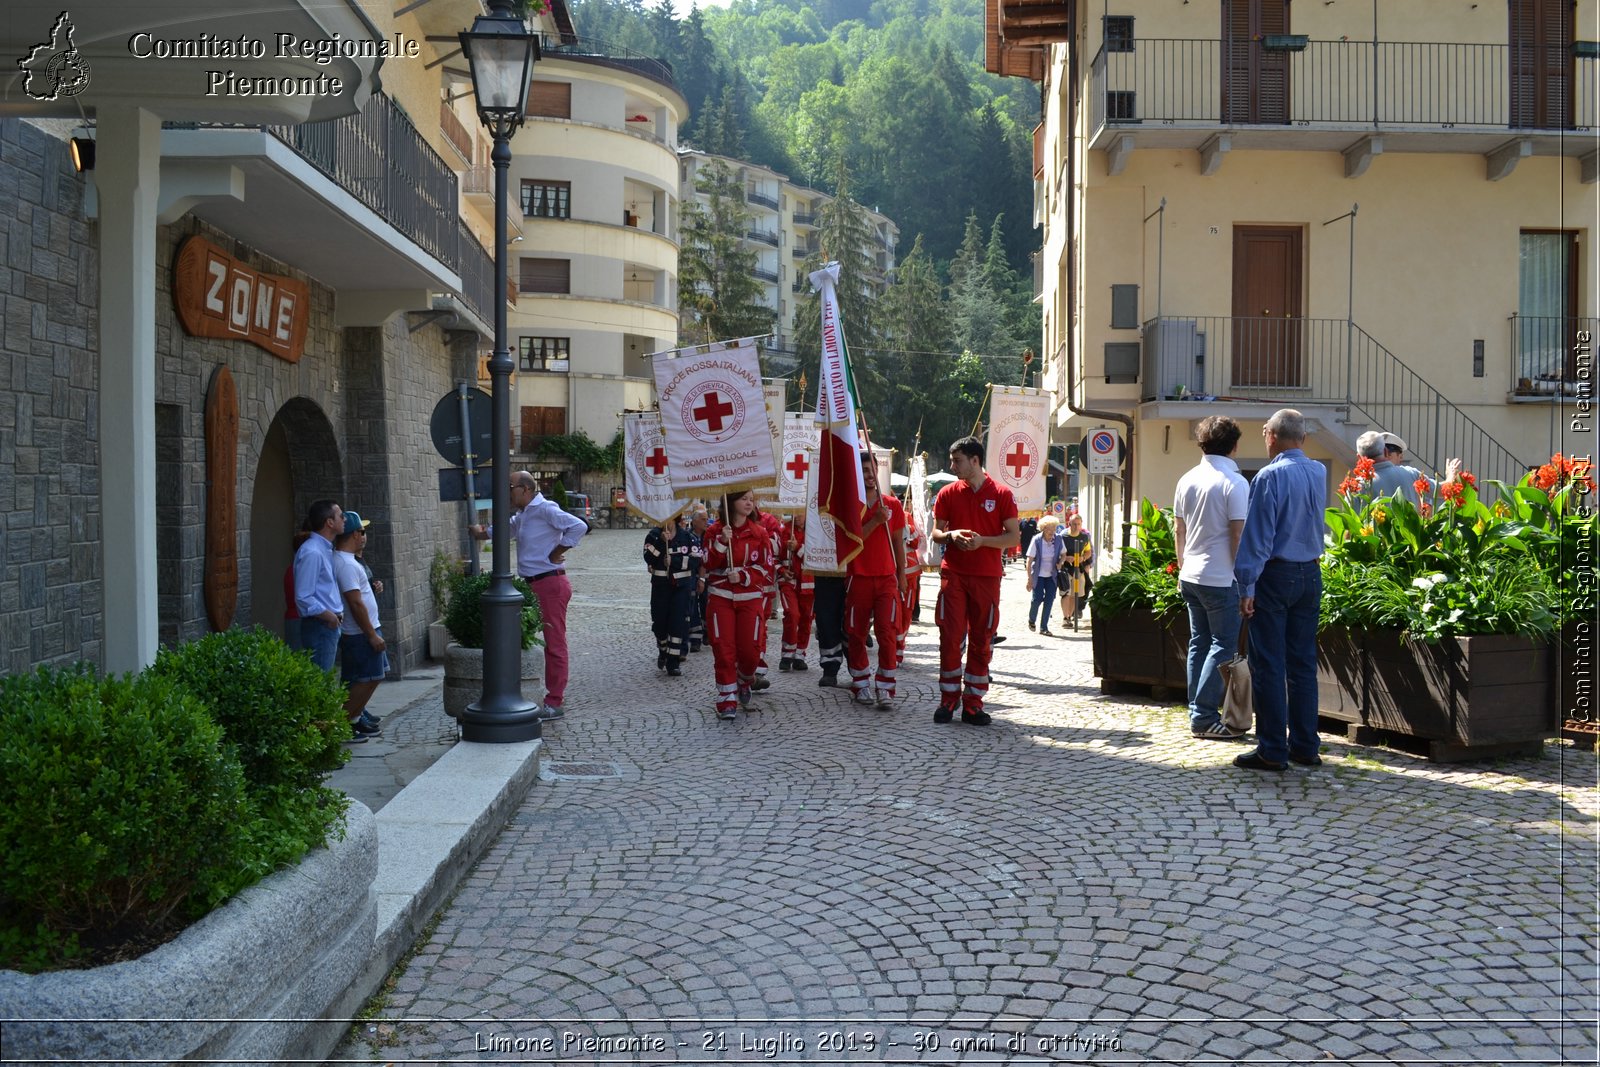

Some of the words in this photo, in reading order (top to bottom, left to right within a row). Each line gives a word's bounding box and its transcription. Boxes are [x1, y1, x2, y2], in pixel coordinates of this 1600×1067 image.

[205, 259, 296, 341] ZONE
[824, 322, 840, 359] LIMONE
[830, 360, 841, 370] DI
[662, 371, 687, 402] CROCE
[685, 360, 721, 376] ROSSA
[720, 361, 757, 387] ITALIANA
[832, 372, 849, 420] COMITATO
[682, 396, 702, 438] CONVENZIONE
[698, 382, 725, 393] GINEVRA
[730, 391, 744, 418] AGOSTO
[684, 455, 725, 468] COMITATO
[726, 450, 758, 462] LOCALE
[687, 471, 718, 483] LIMONE
[718, 465, 759, 478] PIEMONTE
[635, 494, 673, 503] SAVIGLIA
[806, 555, 834, 563] BORGO
